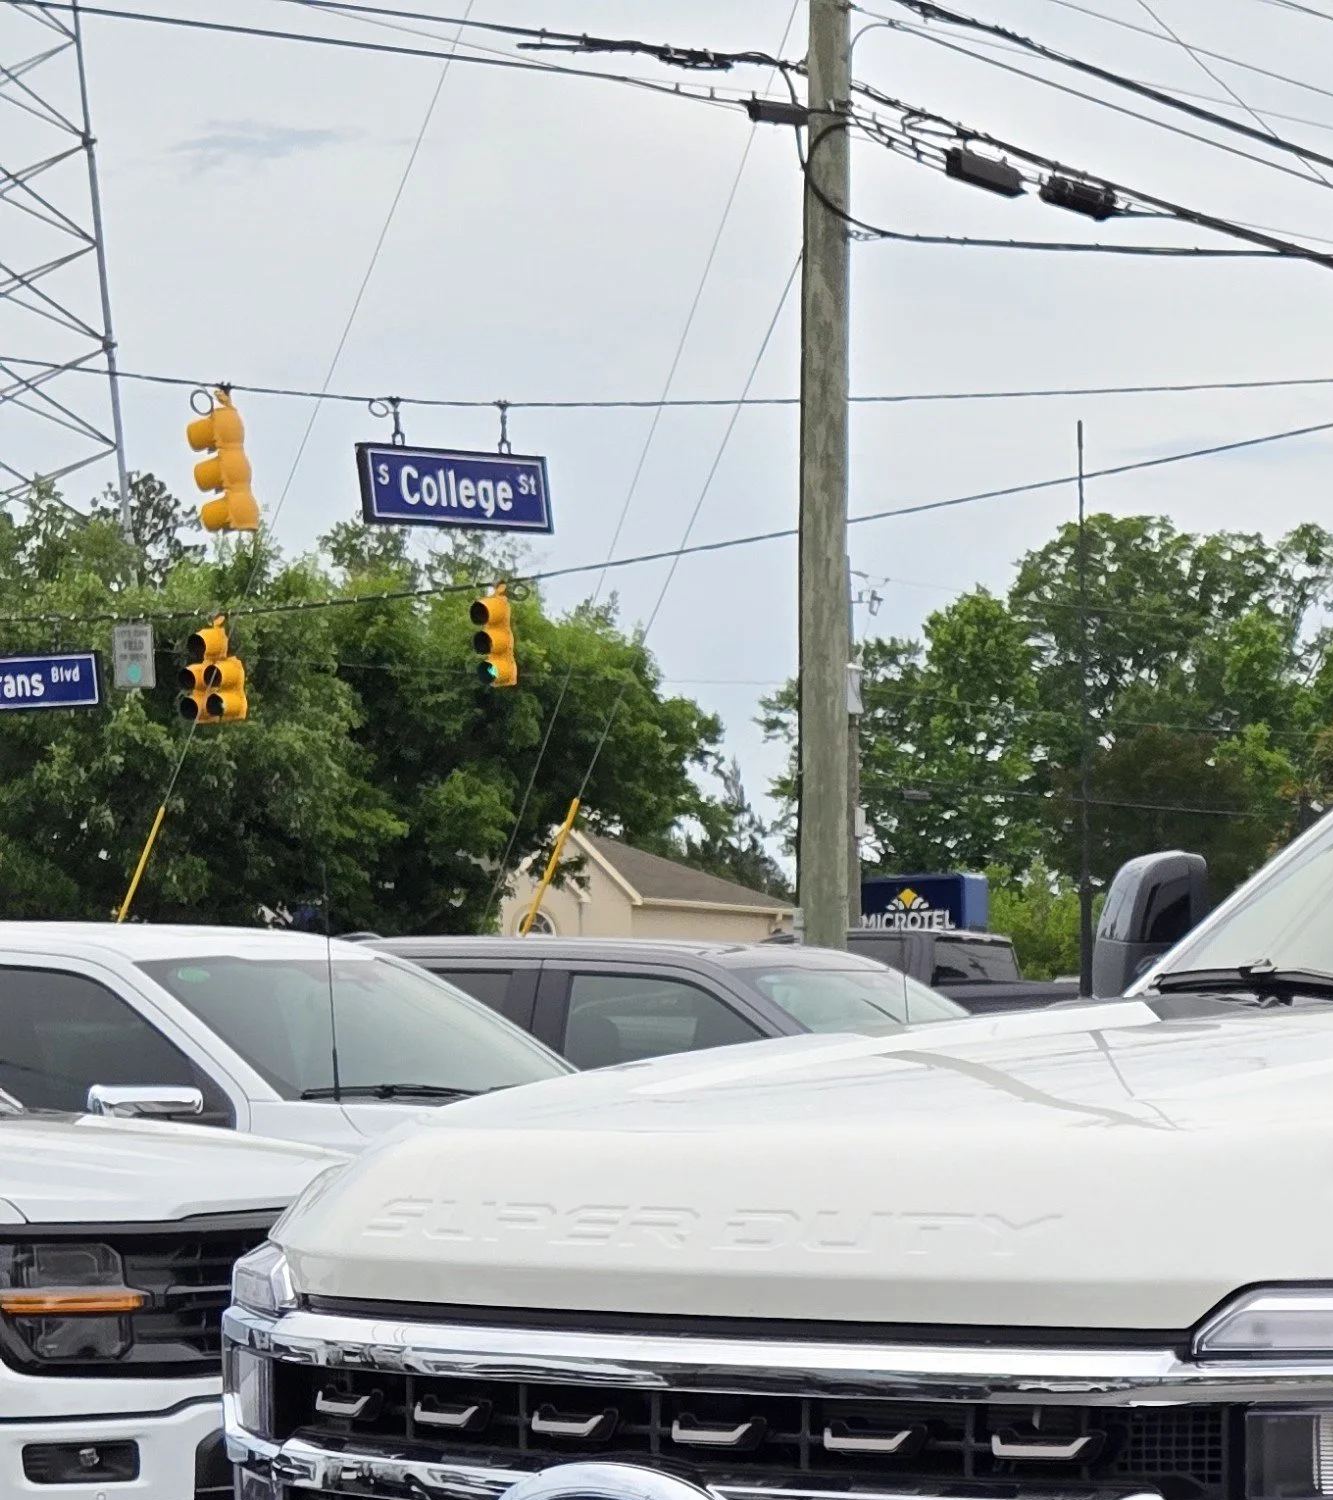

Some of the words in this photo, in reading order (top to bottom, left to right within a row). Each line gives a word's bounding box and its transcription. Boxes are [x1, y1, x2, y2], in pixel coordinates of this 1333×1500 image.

[377, 463, 390, 485] S
[401, 465, 513, 518] College
[517, 473, 537, 496] St
[0, 672, 44, 698] ans
[51, 663, 80, 683] Blvd
[861, 910, 956, 930] MICROTEL
[362, 1196, 702, 1250] SUPER
[710, 1206, 1064, 1256] DUTY
